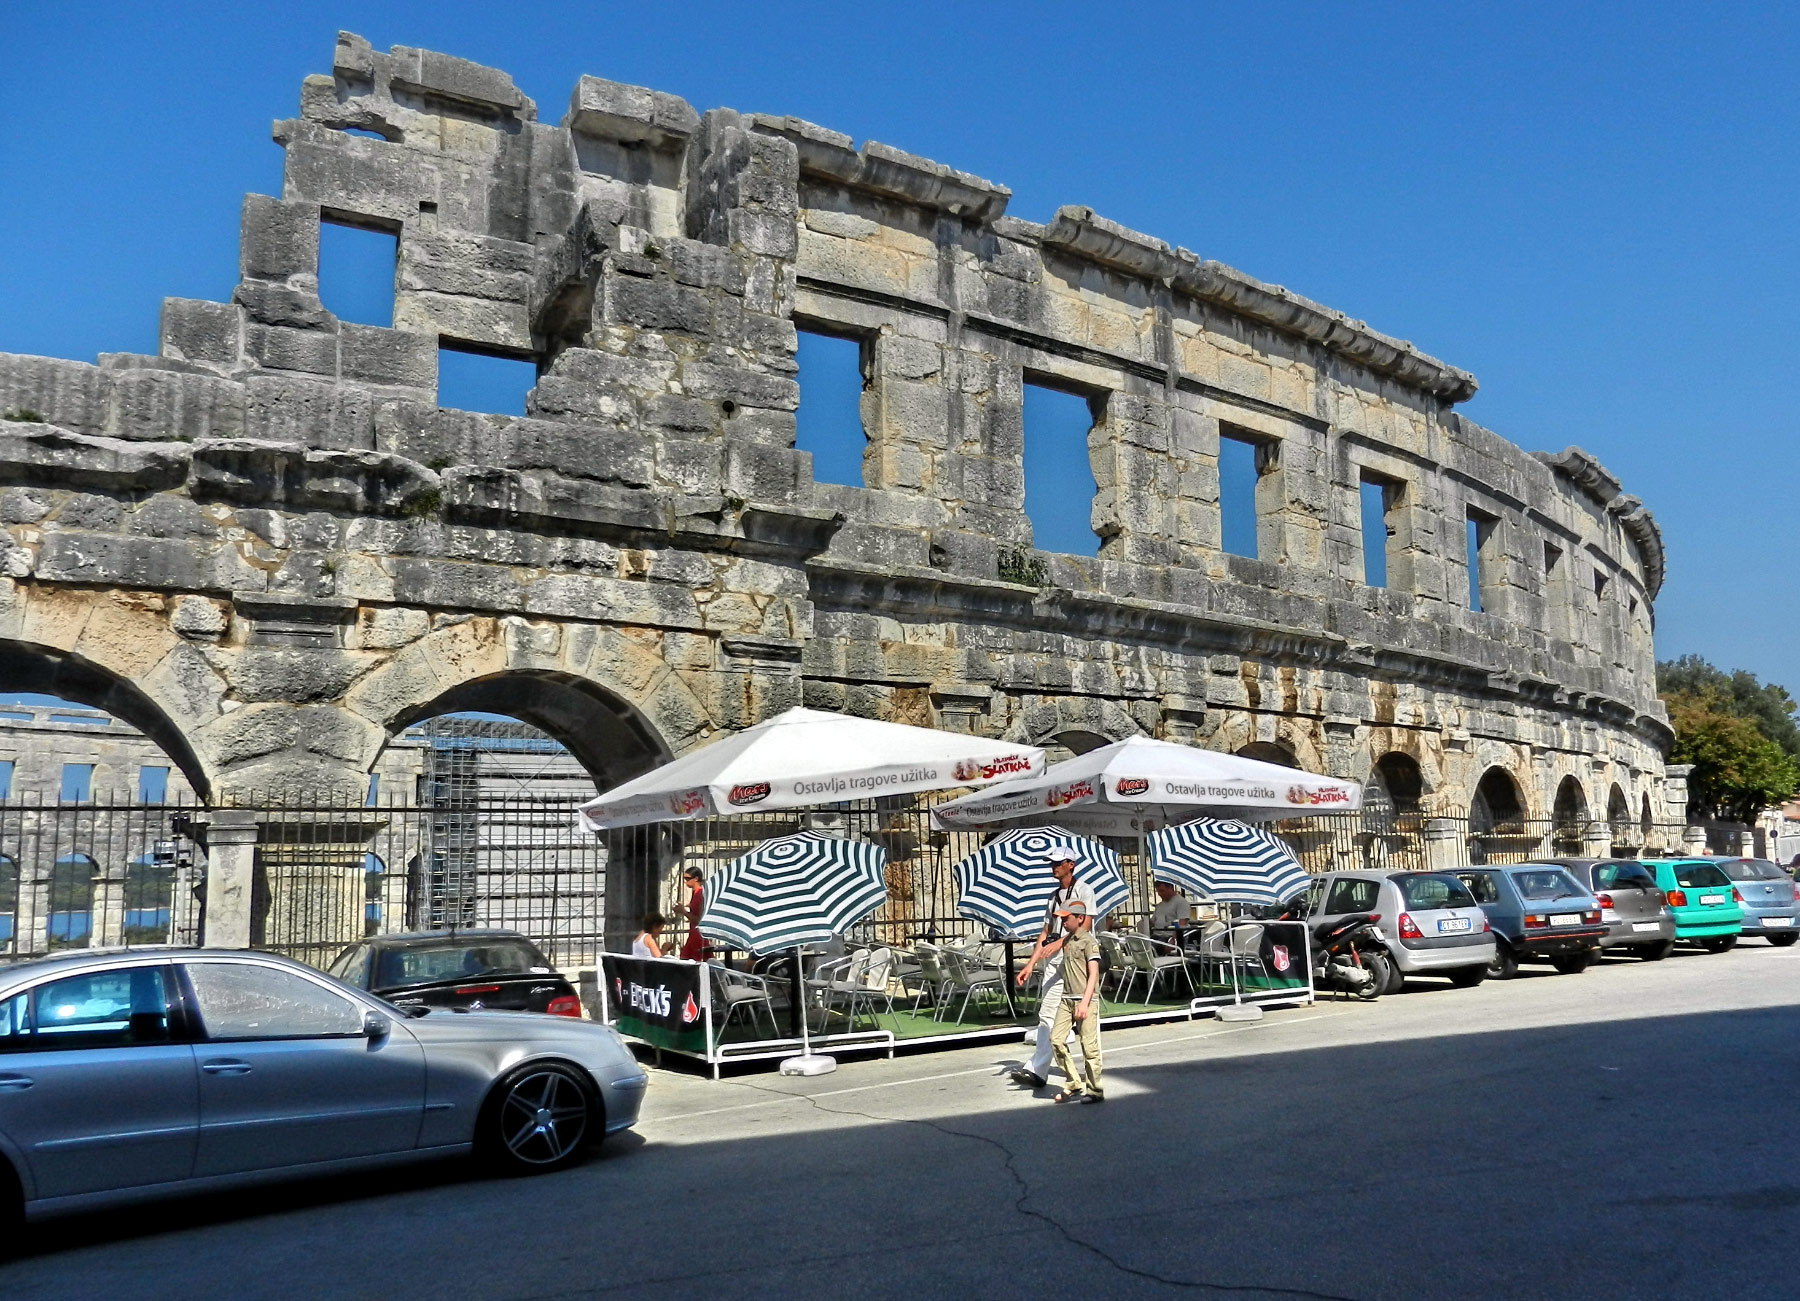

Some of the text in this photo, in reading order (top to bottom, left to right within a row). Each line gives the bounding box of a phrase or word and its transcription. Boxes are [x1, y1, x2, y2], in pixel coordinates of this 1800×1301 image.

[982, 757, 1031, 779] SLATKAČ
[793, 767, 938, 795] Ostavlja tragove užitka
[1115, 777, 1149, 794] Mars
[1165, 782, 1276, 799] Ostavlja tragove užitka
[727, 782, 771, 803] Mars
[992, 801, 1018, 815] tragove
[1017, 796, 1038, 809] užitka
